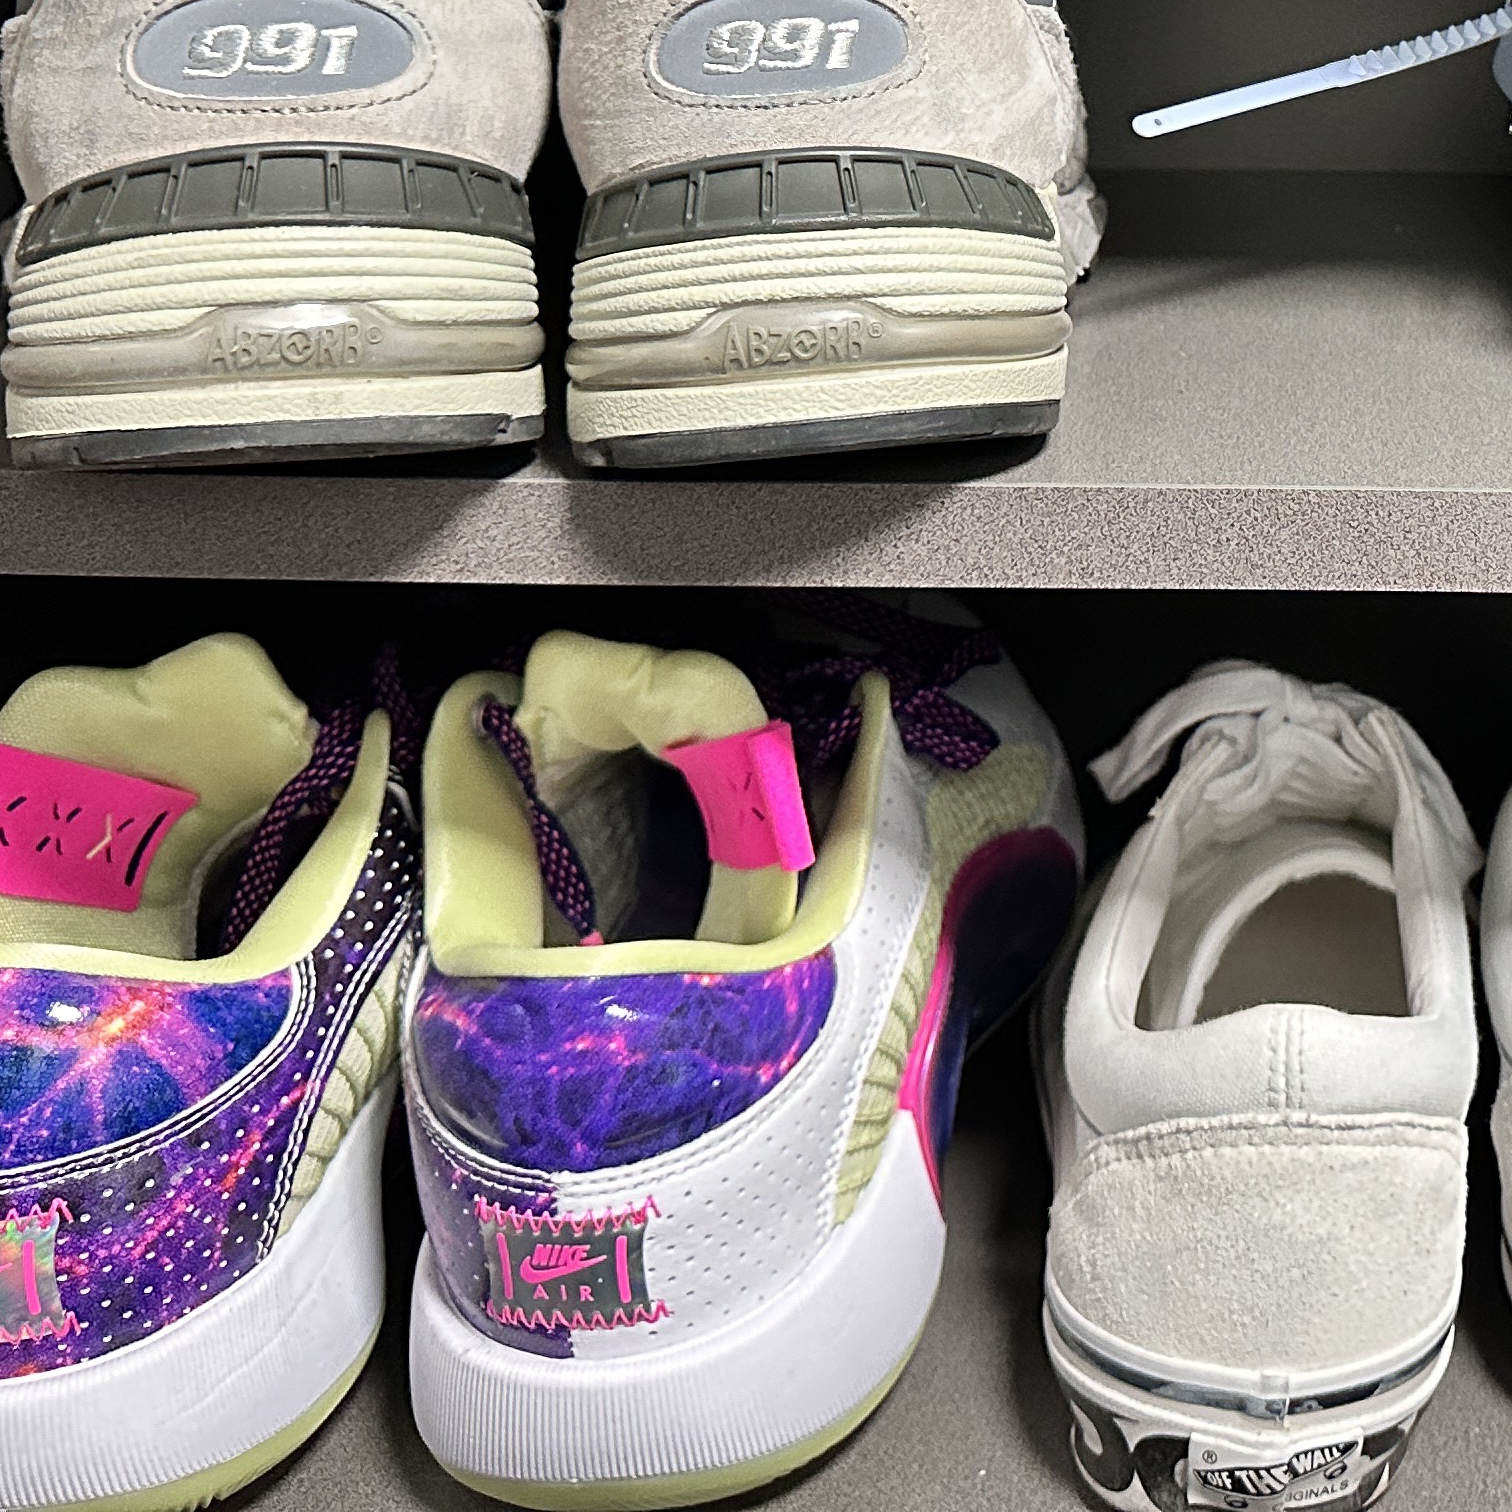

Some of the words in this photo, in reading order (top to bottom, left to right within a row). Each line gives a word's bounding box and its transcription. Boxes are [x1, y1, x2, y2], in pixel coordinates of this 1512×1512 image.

[182, 21, 359, 78] 991
[702, 16, 860, 75] 991
[532, 1243, 591, 1266] NIKE
[533, 1284, 595, 1302] AIR
[1235, 1465, 1293, 1495] THE
